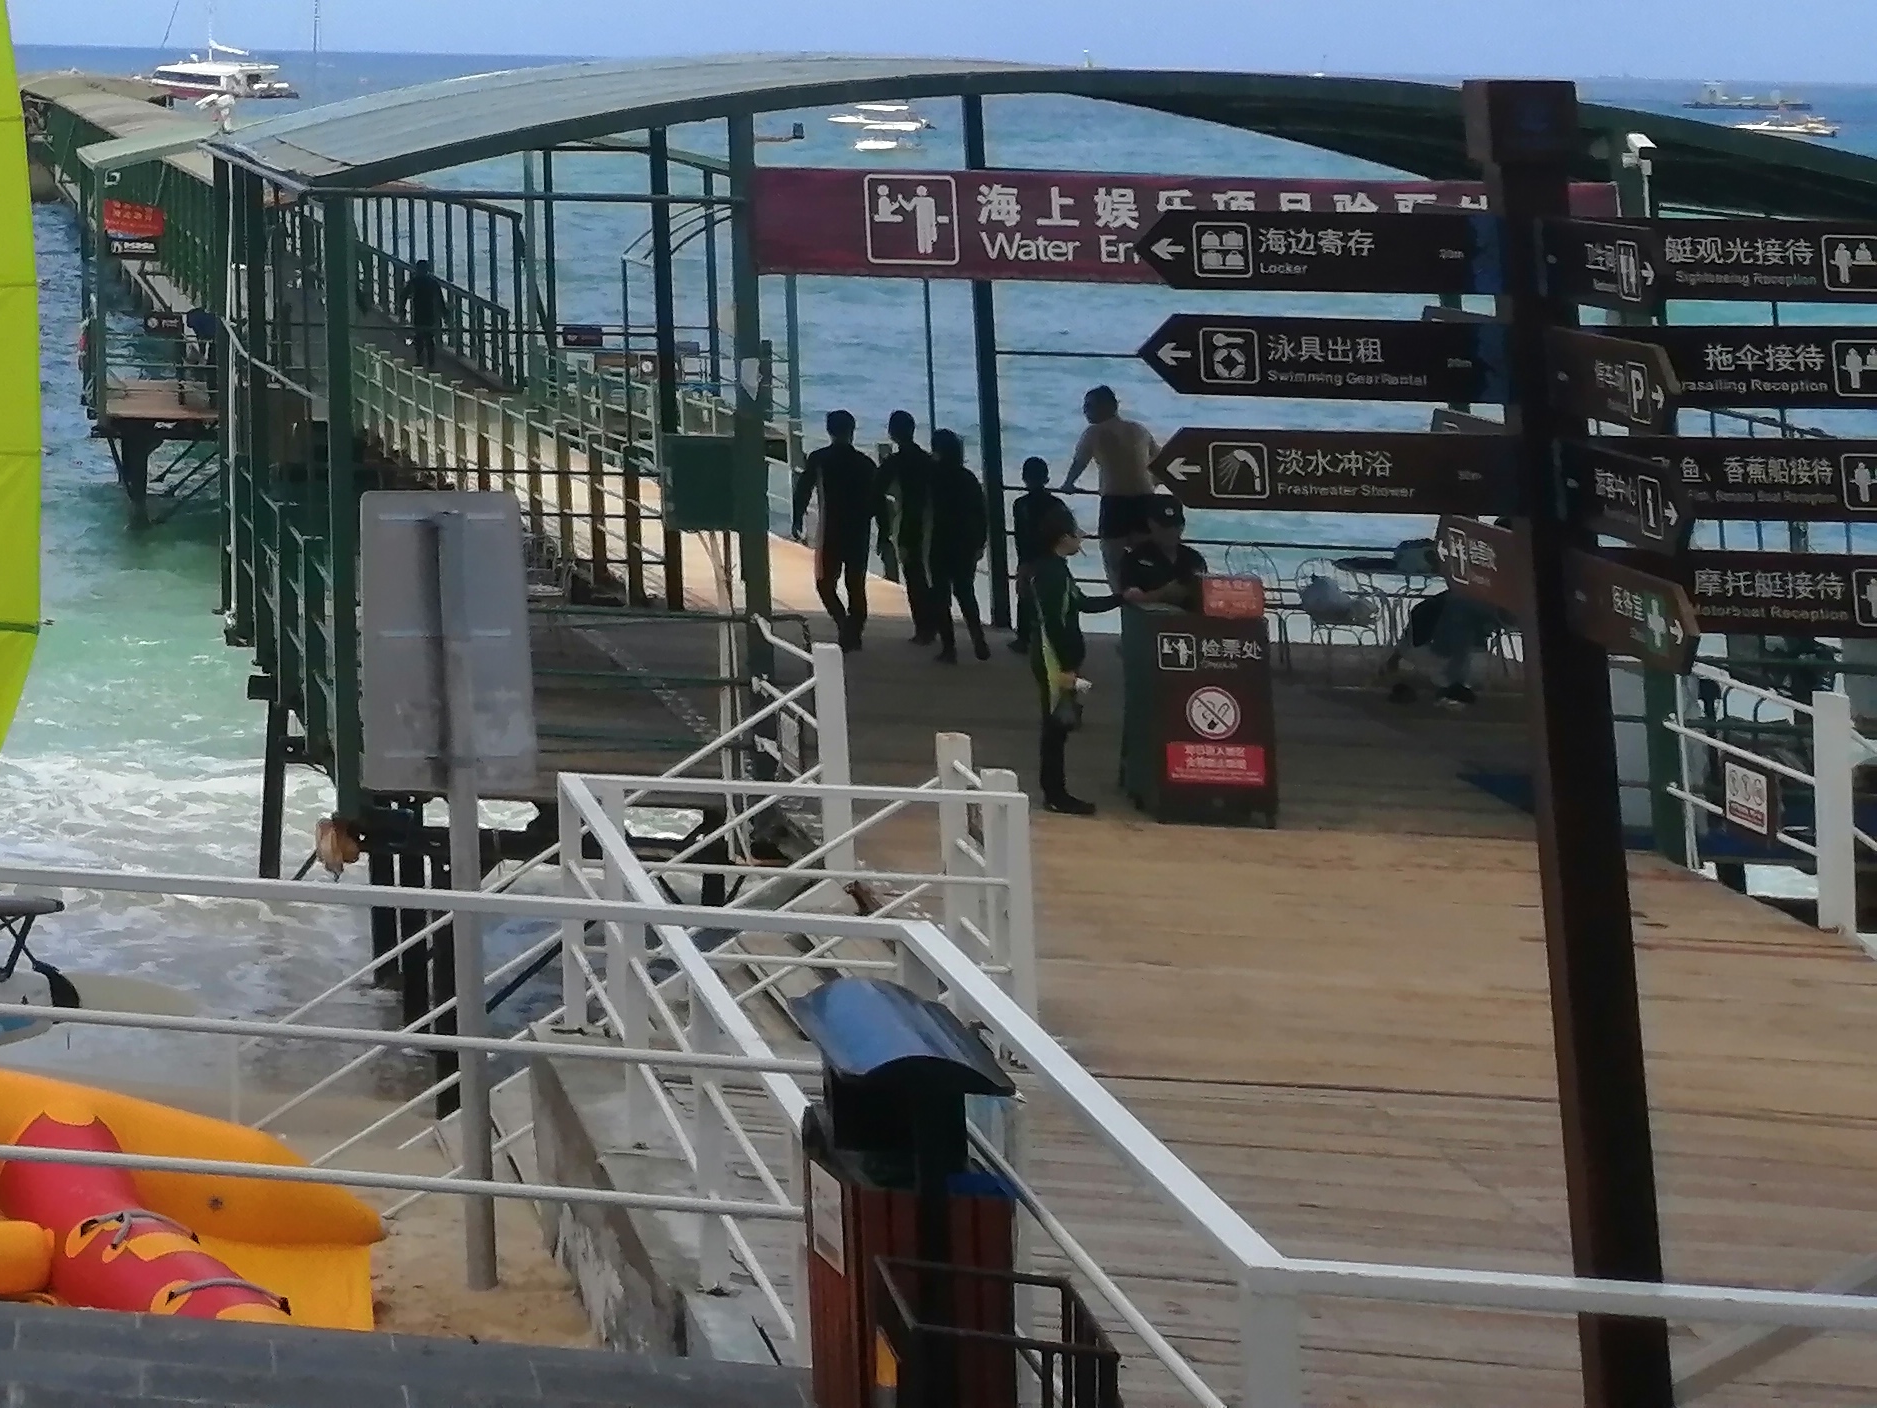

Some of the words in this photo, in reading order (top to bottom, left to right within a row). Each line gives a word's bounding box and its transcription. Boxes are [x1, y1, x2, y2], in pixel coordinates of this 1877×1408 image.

[979, 231, 1081, 262] Water
[1258, 227, 1375, 257] 海边寄存
[1260, 262, 1308, 275] Locker
[1267, 335, 1384, 365] 泳具出租
[1703, 343, 1825, 372] 拖伞接待
[1267, 369, 1344, 387] Swimming
[1276, 448, 1394, 477] 淡水冲浴
[1652, 455, 1833, 486] 鱼、香蕉船接待
[1693, 568, 1845, 600] 摩托艇接待
[1696, 603, 1767, 618] otorboat
